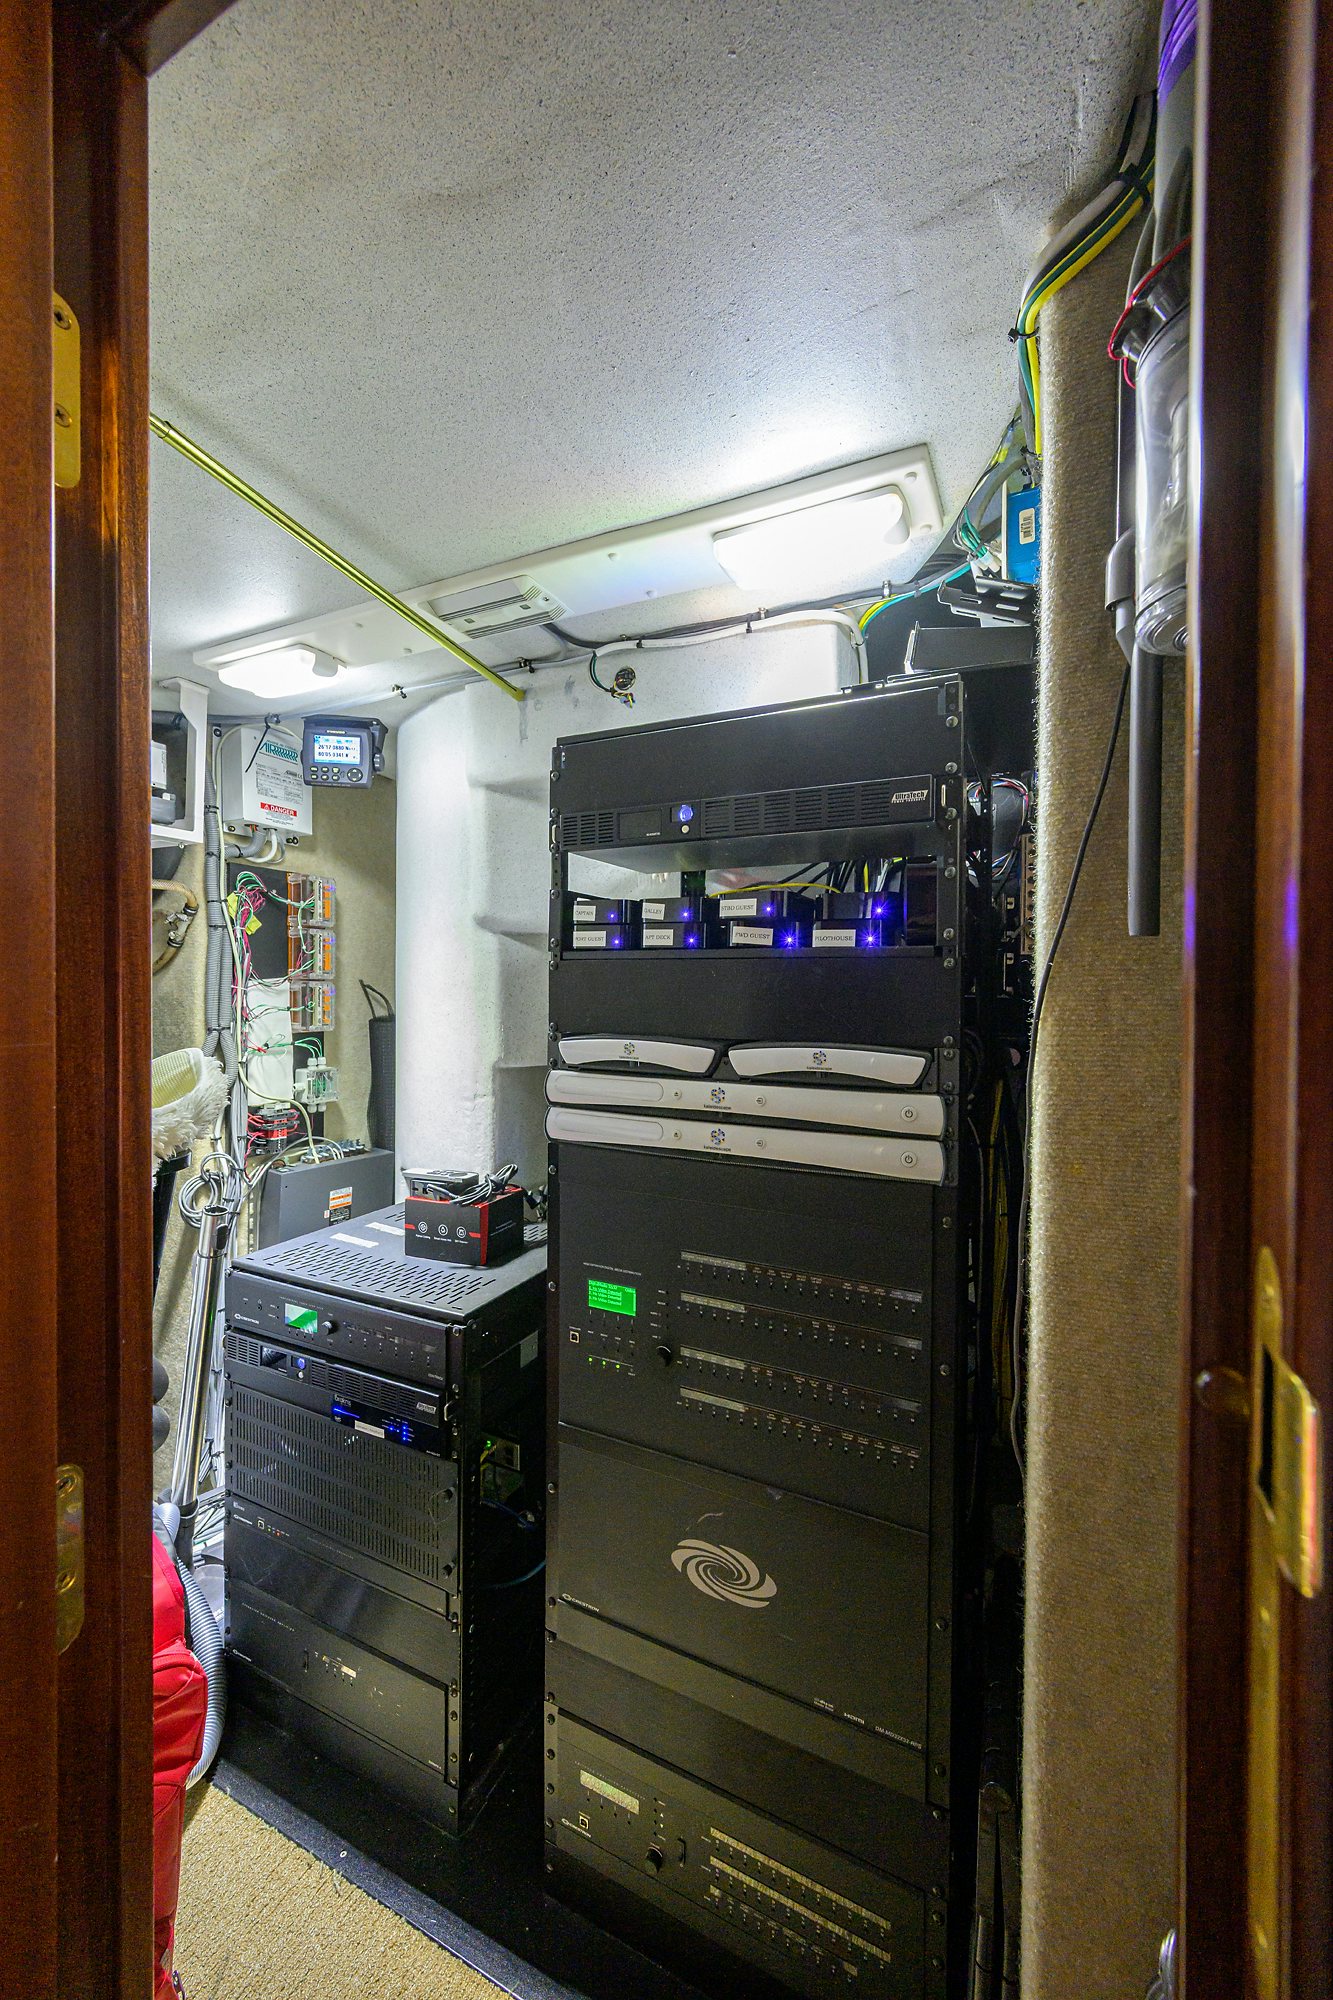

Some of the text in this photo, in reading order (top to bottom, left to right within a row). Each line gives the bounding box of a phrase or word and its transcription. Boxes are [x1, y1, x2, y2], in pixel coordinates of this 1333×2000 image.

[895, 790, 925, 800] UltraTech
[270, 804, 295, 815] DANGER
[643, 907, 663, 915] GALLEY
